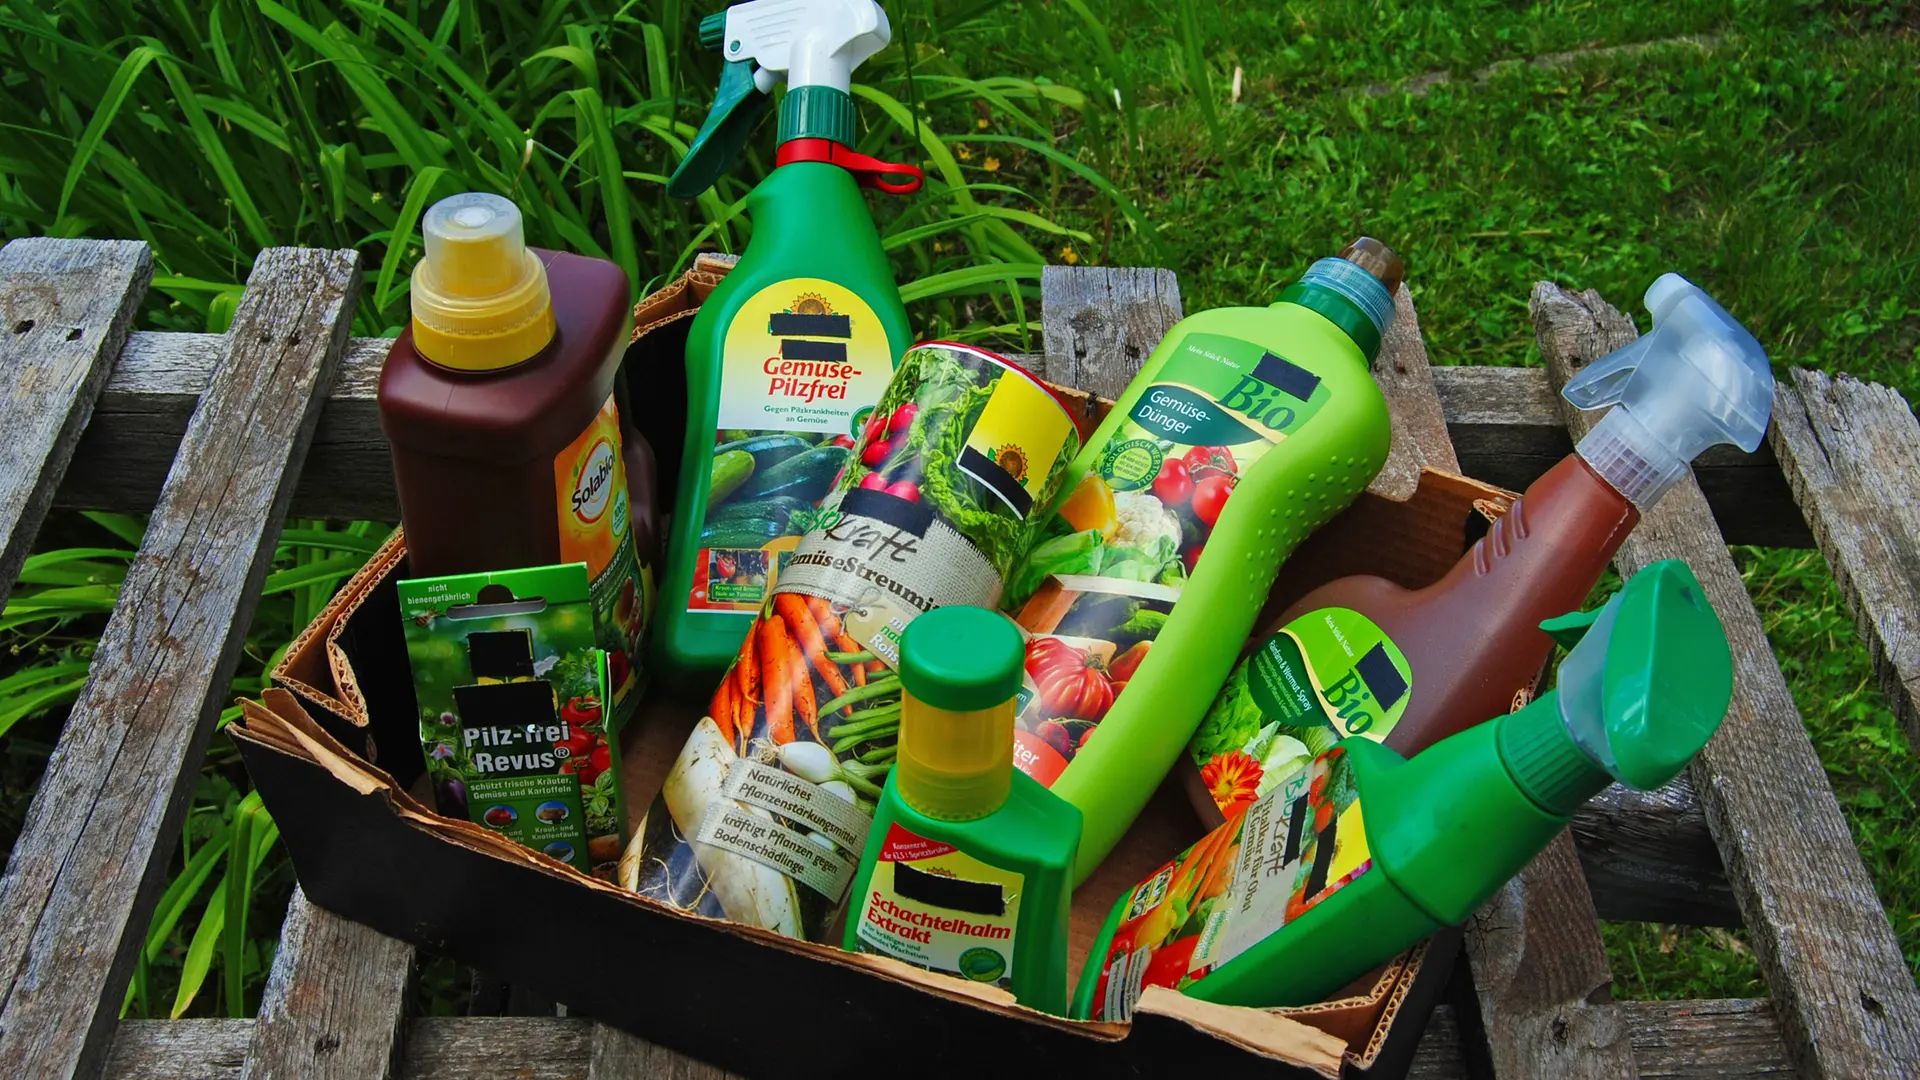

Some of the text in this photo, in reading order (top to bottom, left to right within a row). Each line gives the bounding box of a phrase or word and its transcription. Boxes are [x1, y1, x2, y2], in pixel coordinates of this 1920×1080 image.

[763, 357, 862, 380] Gemüse-
[768, 377, 848, 403] Pilzfrei
[1150, 390, 1212, 422] Gemüse-
[1214, 373, 1295, 430] Bio
[764, 405, 850, 417] Gegen Pilzkrankheiten
[797, 416, 829, 424] Gemüse
[1138, 405, 1193, 435] Dünger
[572, 444, 616, 513] Solabiol
[428, 584, 448, 593] nicht
[785, 549, 940, 613] emüseStreumi
[407, 591, 471, 605] bienengefährlich
[869, 633, 900, 665] Rohs
[1283, 664, 1301, 693] Wermut
[1297, 689, 1313, 712] Spray
[1320, 668, 1374, 735] Bio
[463, 720, 570, 748] Pilz-frei
[470, 777, 572, 792] schützt frische Kräuter,
[473, 785, 572, 800] Gemüse und Kartoffeln
[747, 768, 812, 801] Natürliches
[739, 782, 858, 846] Pflanzenstärkungsmittel
[531, 831, 579, 840] Knollenfäule
[713, 827, 805, 874] Bodenschädlinge
[721, 813, 838, 875] kräftigt Pflanzen gegen
[1241, 803, 1262, 873] & Gemüse
[1241, 794, 1275, 914] Vitalkur für Obst
[867, 906, 932, 945] Extrakt
[870, 891, 1012, 940] Schachtelhalm
[889, 942, 930, 960] Wachstum
[906, 943, 921, 951] und
